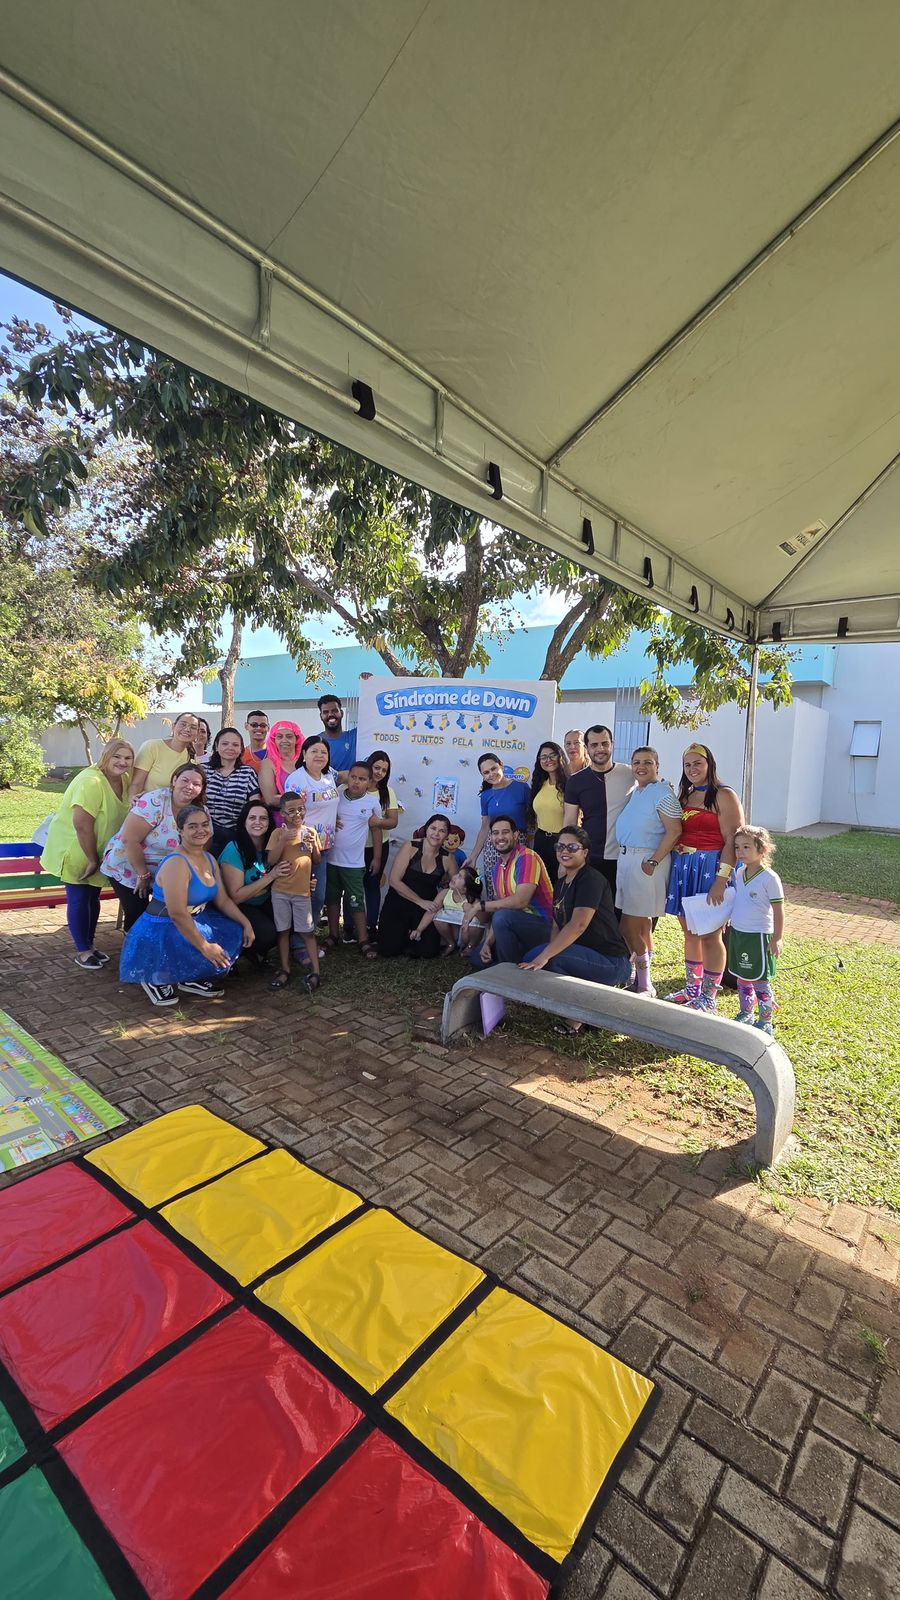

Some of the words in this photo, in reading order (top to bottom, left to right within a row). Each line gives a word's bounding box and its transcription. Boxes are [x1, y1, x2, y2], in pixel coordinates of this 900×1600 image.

[383, 690, 459, 710] Síndrome
[460, 689, 481, 706] de
[482, 690, 531, 712] Down
[374, 733, 400, 742] TODOS
[411, 734, 445, 745] JUNTOS
[452, 737, 473, 747] PELA
[482, 738, 526, 751] INCLUSÃO!
